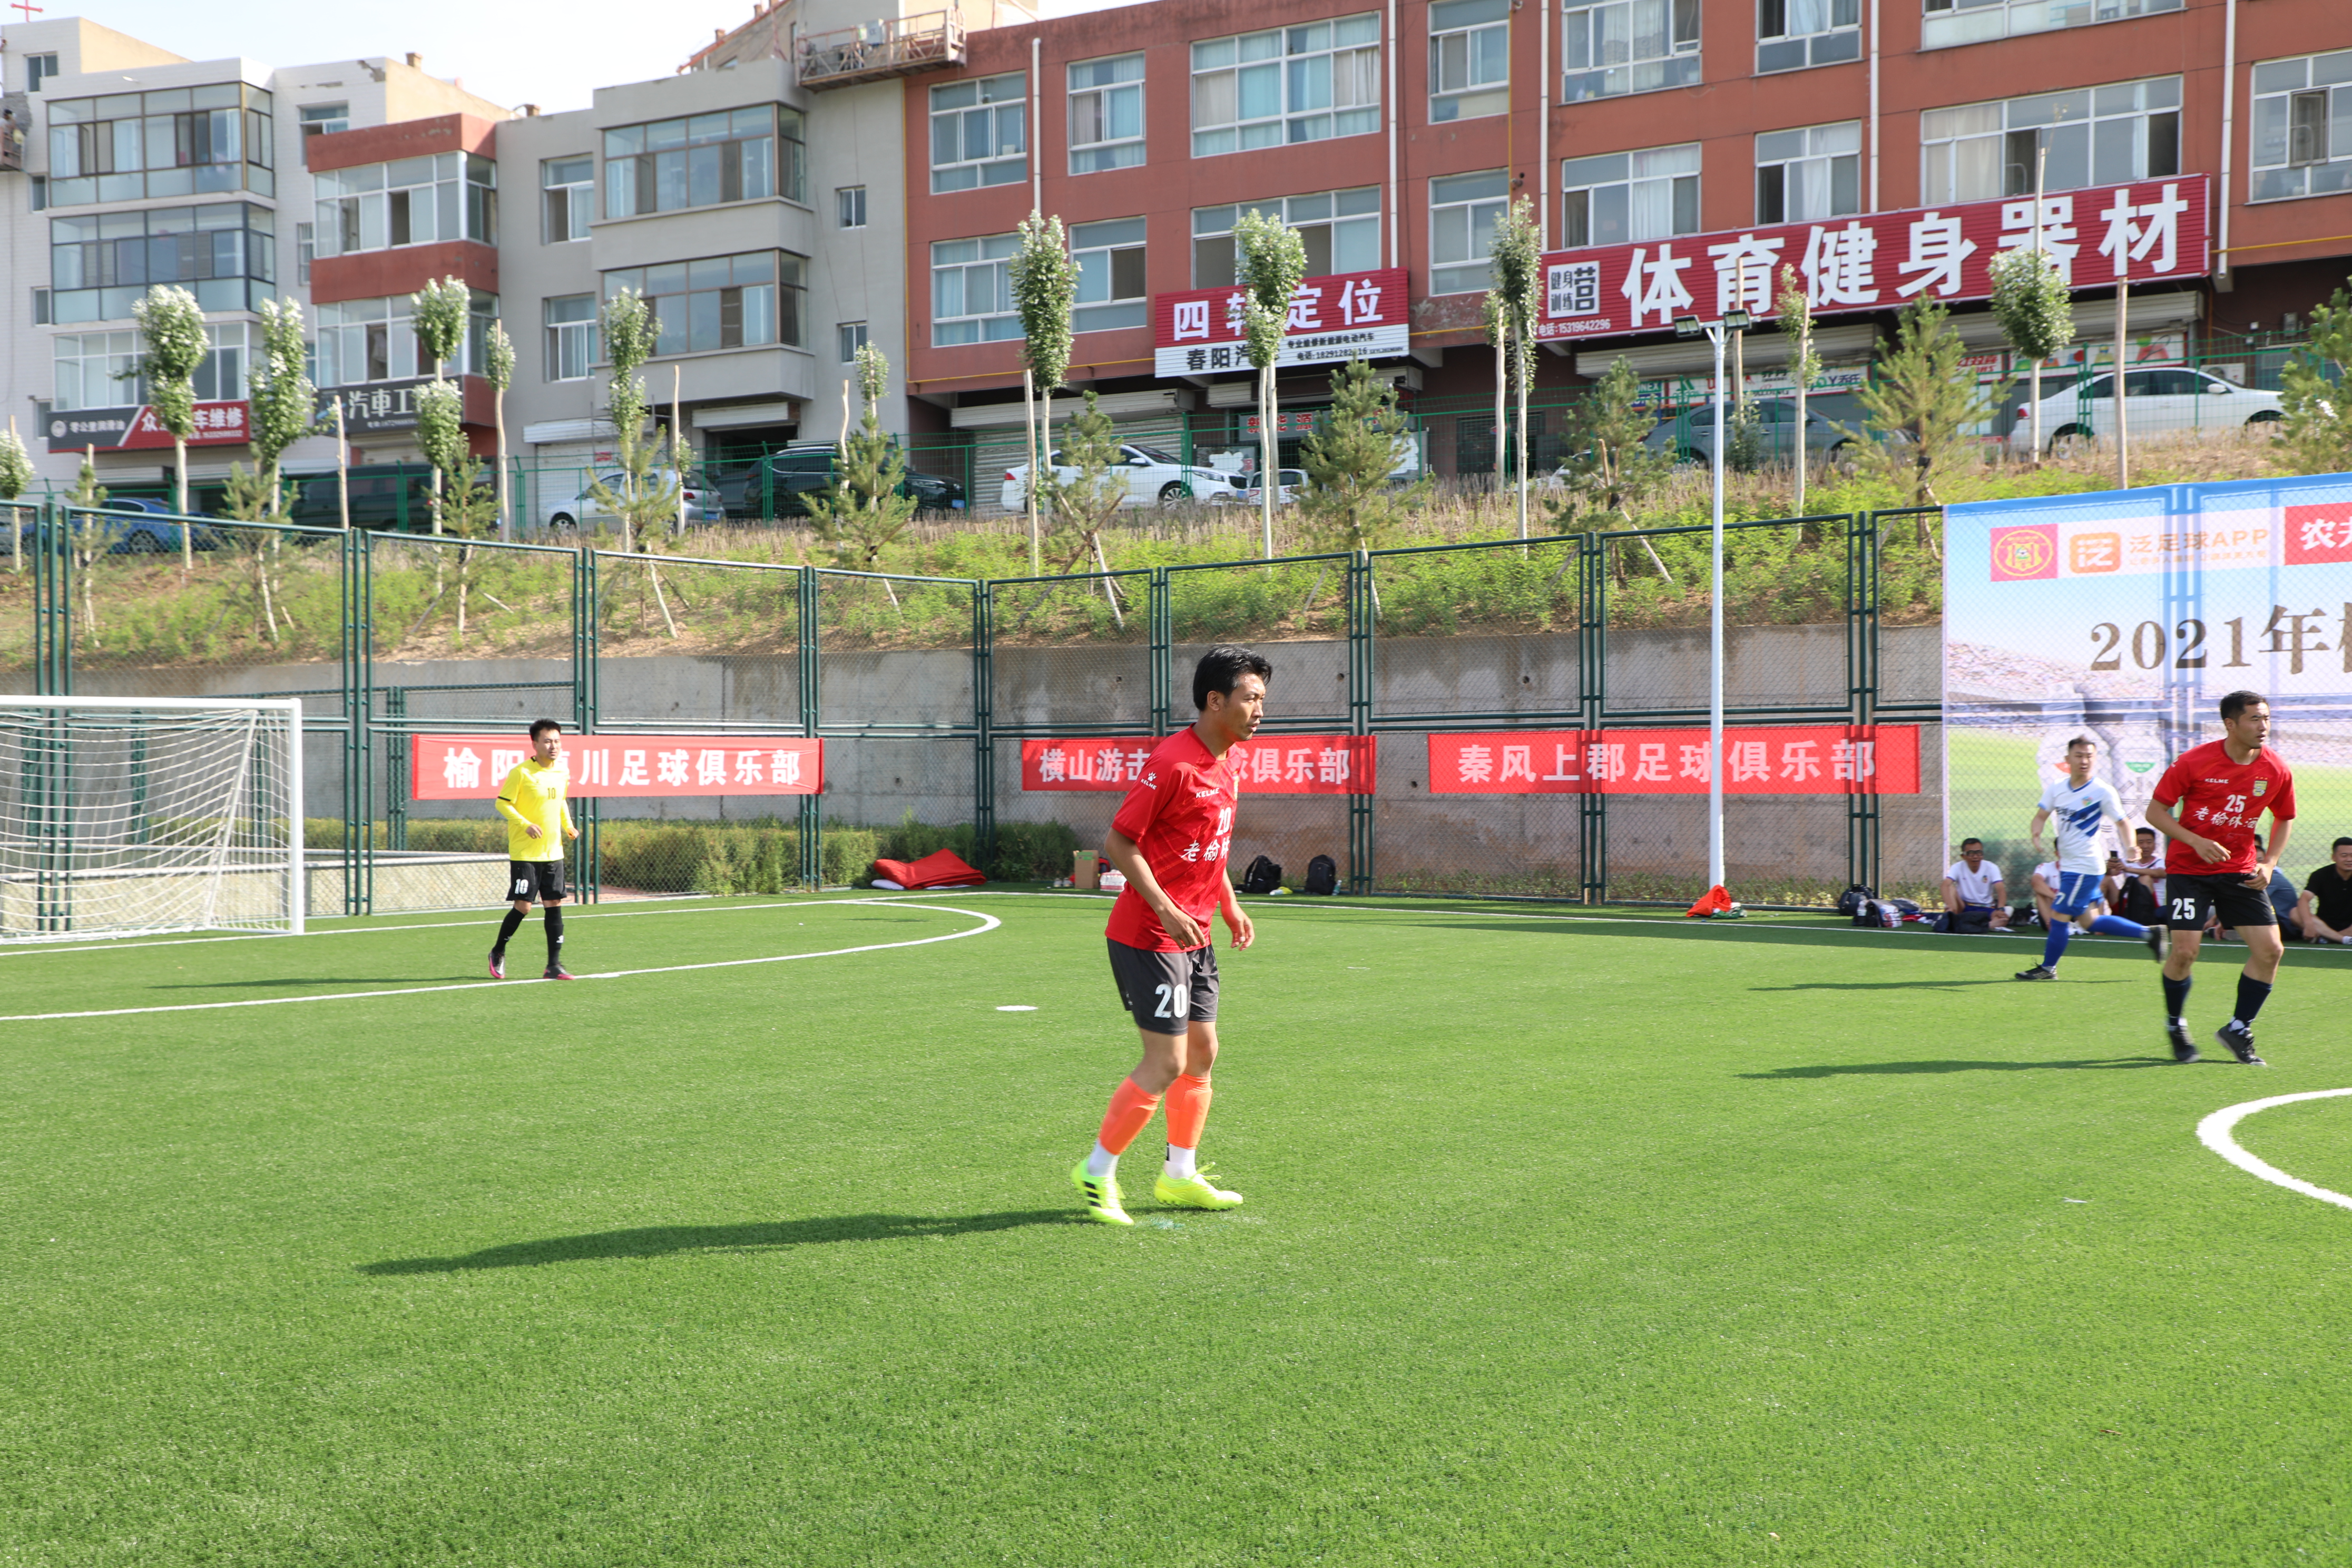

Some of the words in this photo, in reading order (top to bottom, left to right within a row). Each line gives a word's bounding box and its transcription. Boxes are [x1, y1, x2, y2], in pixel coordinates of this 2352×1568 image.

[1621, 183, 2188, 328] 体育健身器材
[1551, 270, 1573, 289] 健身
[1574, 266, 1596, 311] 营
[1297, 347, 1367, 360] 电话:1829128216
[2129, 529, 2269, 553] 泛足球APP
[2091, 602, 2352, 674] 2021年
[444, 747, 800, 788] 榆阳川足球俱乐部
[1039, 747, 1350, 784] 横山游击俱乐部
[1458, 741, 1875, 783] 秦风上郡足球俱乐部
[547, 788, 556, 799] 10
[1140, 778, 1157, 790] KELME
[1195, 788, 1220, 798] KELME
[2224, 794, 2247, 813] 25
[1216, 807, 1232, 836] 20
[515, 878, 529, 894] 10
[2172, 898, 2196, 920] 25
[1154, 983, 1188, 1018] 20
